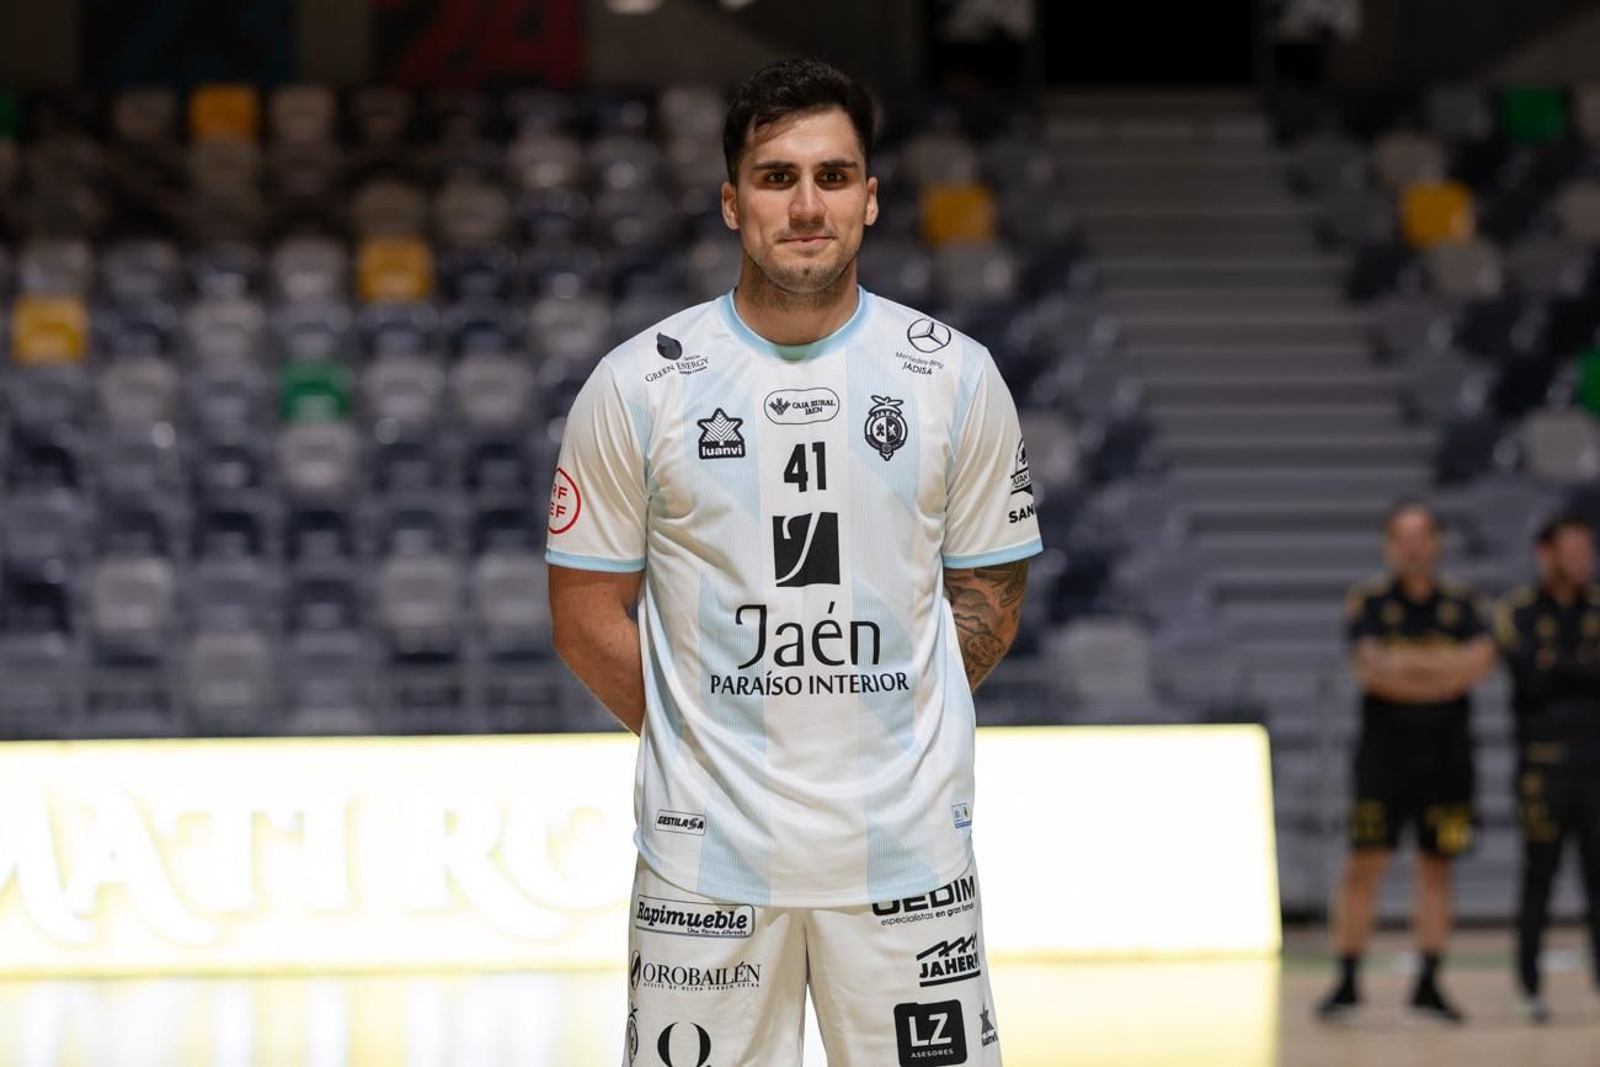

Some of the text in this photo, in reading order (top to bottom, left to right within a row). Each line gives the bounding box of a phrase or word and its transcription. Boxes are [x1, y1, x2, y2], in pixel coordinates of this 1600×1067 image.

[645, 364, 675, 382] GREEN
[676, 356, 709, 370] ENERGY
[902, 361, 932, 375] JADISA
[811, 399, 836, 407] RURAL
[783, 441, 827, 493] 41
[1008, 503, 1034, 523] SAN
[735, 601, 881, 669] Jaén
[710, 670, 910, 695] PARAÍSO INTERIOR
[636, 901, 748, 930] Rapimueble
[881, 911, 934, 926] especialistas
[936, 910, 946, 918] en
[947, 905, 961, 917] gran
[643, 962, 761, 987] OROBAILÉN
[908, 1013, 952, 1047] LZ
[911, 1048, 954, 1058] ASESORES
